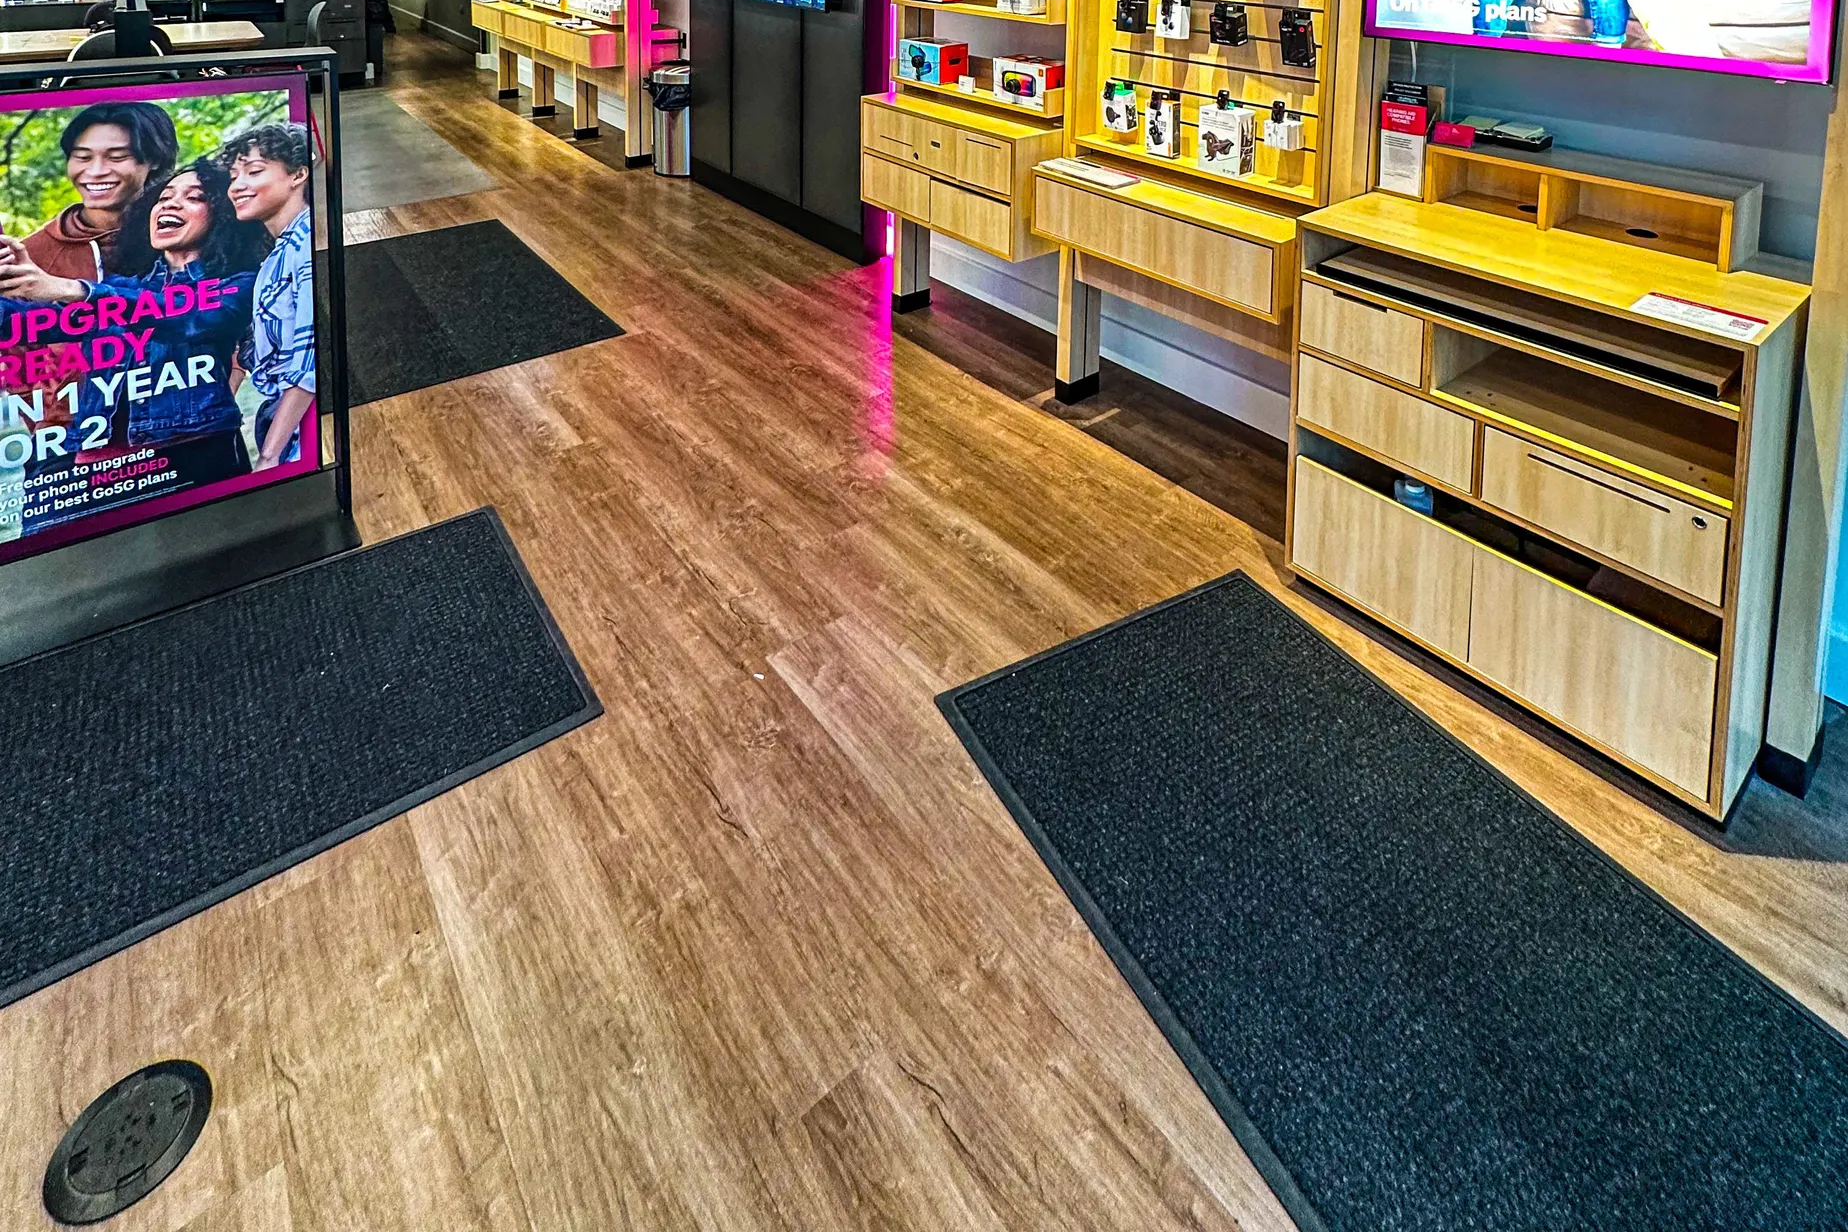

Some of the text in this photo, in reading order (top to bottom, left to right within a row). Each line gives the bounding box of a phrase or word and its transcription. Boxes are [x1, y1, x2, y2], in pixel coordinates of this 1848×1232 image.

[0, 327, 156, 388] READY
[0, 354, 216, 428] N 1 YEAR
[0, 415, 109, 468] OR 2
[73, 464, 89, 478] to
[93, 447, 155, 473] upgrade
[0, 492, 35, 513] your
[39, 478, 88, 501] phone
[91, 457, 169, 486] INCLUDED
[0, 470, 178, 526] on our best Go5G plans
